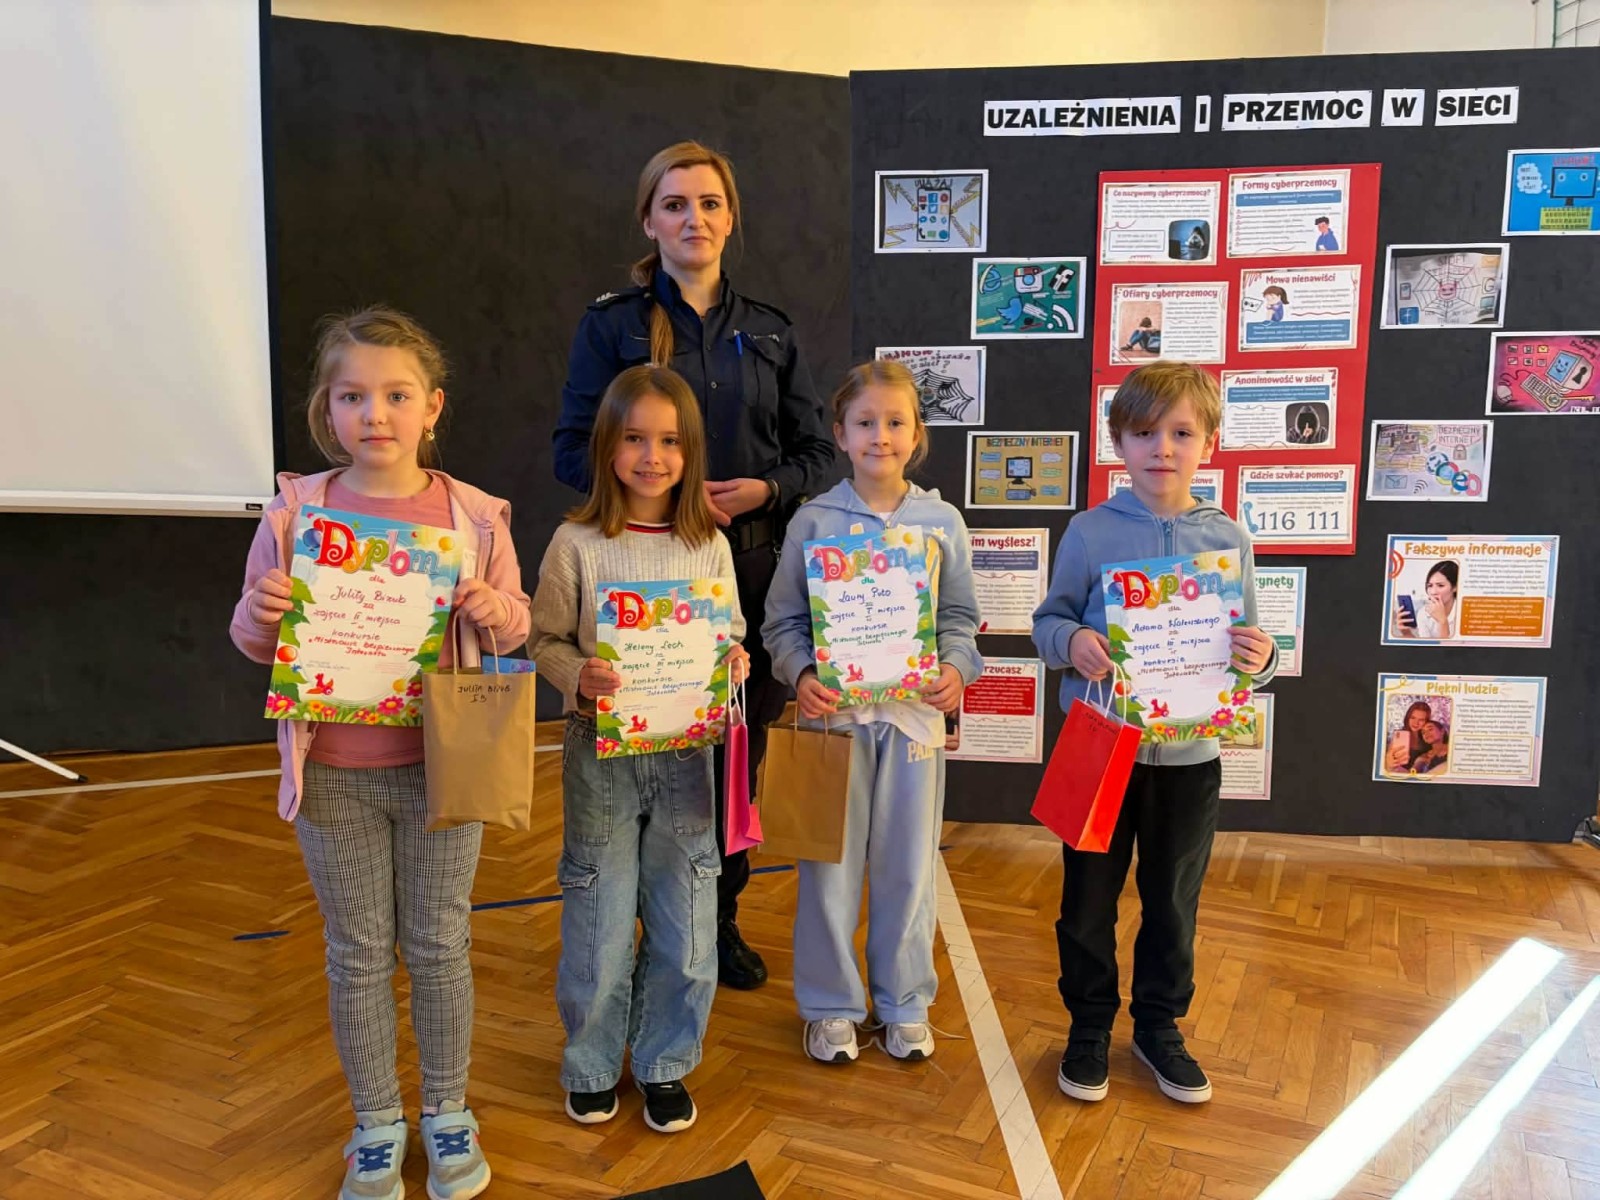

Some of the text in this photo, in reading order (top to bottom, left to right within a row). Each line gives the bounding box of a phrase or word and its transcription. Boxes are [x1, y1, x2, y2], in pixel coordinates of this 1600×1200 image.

[987, 95, 1511, 130] UZALEŻNIENIA I PRZEMOC W SIECI
[1242, 179, 1337, 190] Formy cyberprzemocy
[1266, 273, 1336, 284] Mowa nienawiści
[1123, 289, 1218, 299] Ofiary cyberprzemocy
[1235, 375, 1294, 384] Anonimowość
[1305, 374, 1324, 383] sieci
[1250, 470, 1344, 480] Gdzie szukać pomocy?
[1258, 511, 1339, 530] 116 111
[313, 518, 439, 576] Dyplom
[988, 536, 1036, 549] wyślesz!
[1405, 542, 1541, 558] Fałszywe informacje
[814, 539, 910, 582] Dyplom
[369, 574, 385, 584] dla
[1256, 576, 1294, 589] ynęty
[1113, 563, 1225, 609] Dyplom
[609, 588, 715, 631] Dyplom
[878, 606, 905, 616] miejsca
[366, 615, 400, 628] miejsca
[332, 629, 380, 641] konkursie
[1181, 637, 1211, 648] miejsca
[667, 659, 694, 669] miejsca
[1143, 656, 1185, 666] konkursie
[984, 666, 1022, 674] rzucasz
[632, 676, 673, 685] konkursie
[1427, 682, 1498, 695] Piękni ludzie
